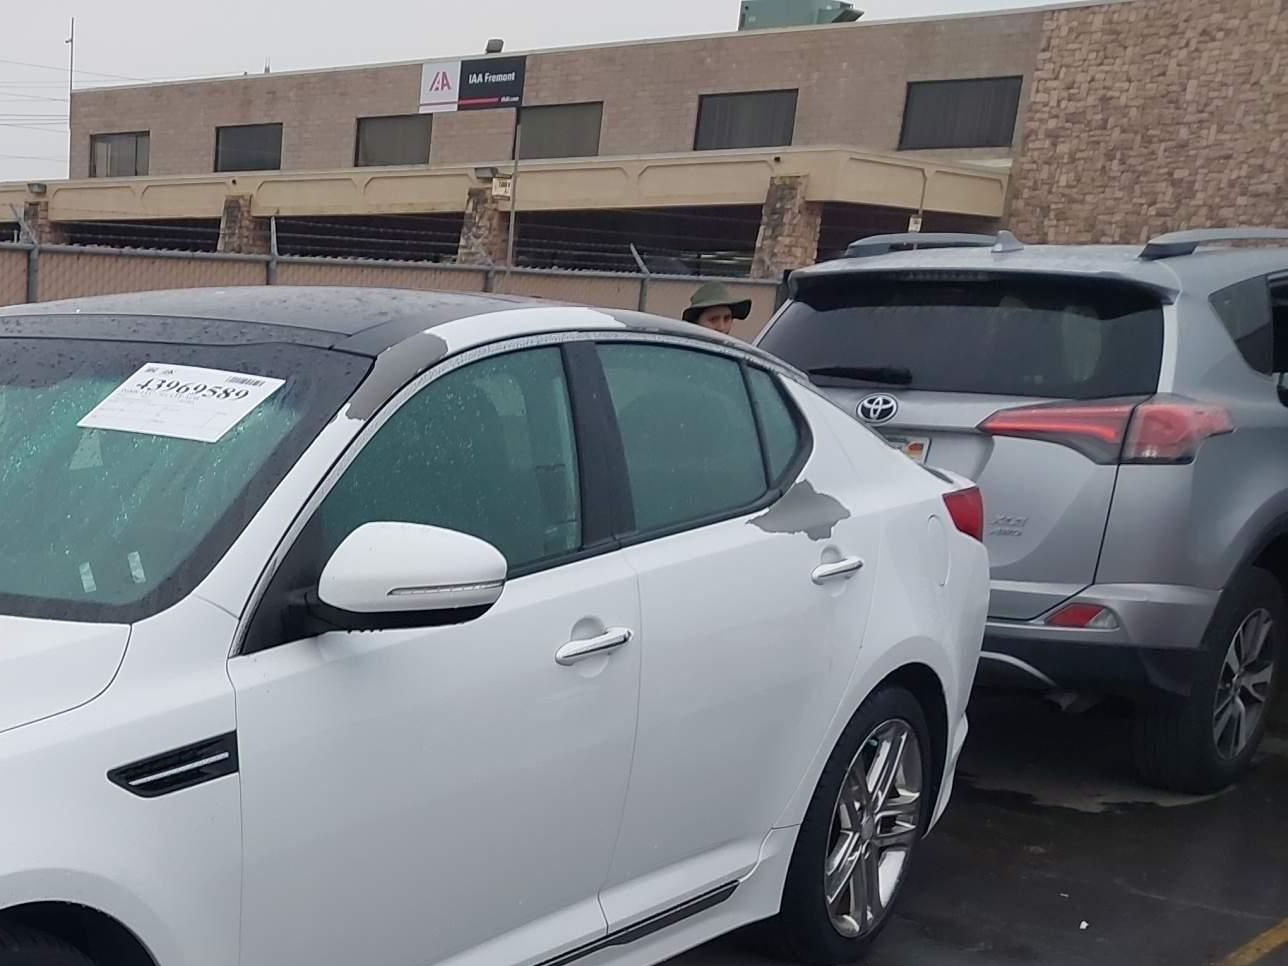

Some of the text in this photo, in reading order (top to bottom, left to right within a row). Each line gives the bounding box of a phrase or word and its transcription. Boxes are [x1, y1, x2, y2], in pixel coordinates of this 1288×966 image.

[468, 72, 516, 84] IAA Fremont
[136, 378, 249, 401] 43969589
